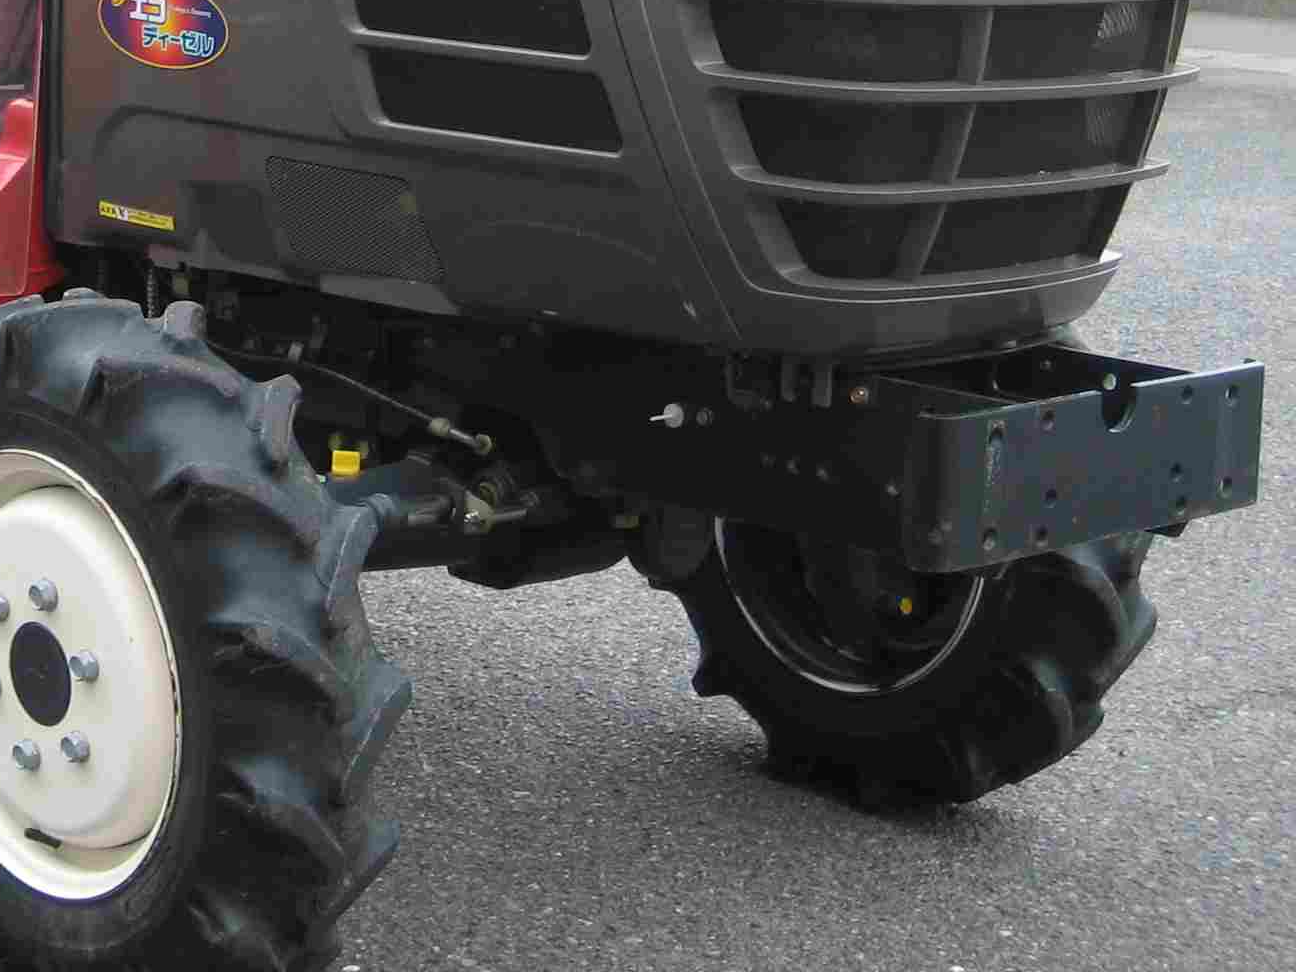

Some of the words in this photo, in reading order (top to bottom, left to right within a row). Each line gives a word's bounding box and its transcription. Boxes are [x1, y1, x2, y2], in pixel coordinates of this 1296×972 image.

[142, 24, 215, 58] ディーゼル
